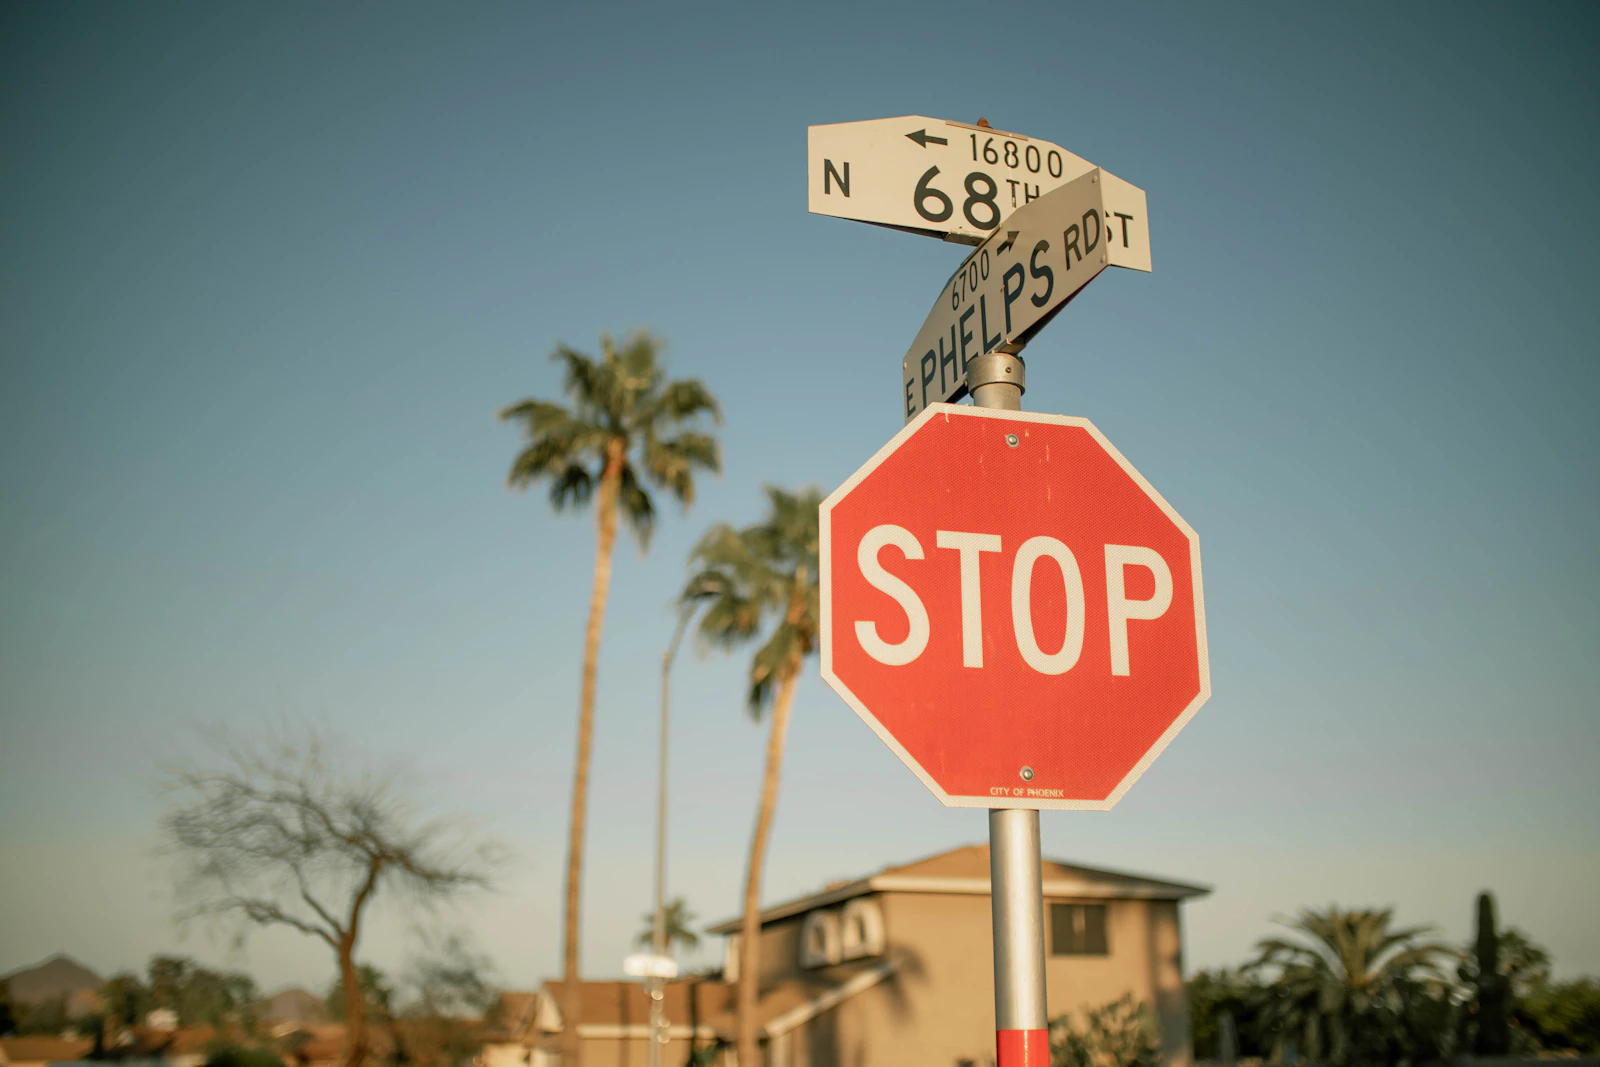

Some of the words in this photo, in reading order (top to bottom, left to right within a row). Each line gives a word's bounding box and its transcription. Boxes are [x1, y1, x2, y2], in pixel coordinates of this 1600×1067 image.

[970, 133, 1062, 178] 16800
[823, 158, 850, 198] N
[1105, 211, 1133, 249] T
[906, 378, 916, 418] E
[921, 240, 1054, 410] PHELPS
[1063, 208, 1100, 271] RD
[952, 249, 989, 311] 6700
[854, 524, 1173, 677] STOP
[990, 787, 1010, 796] CITY
[1013, 788, 1024, 797] OF
[1027, 788, 1064, 798] PHOENIX
